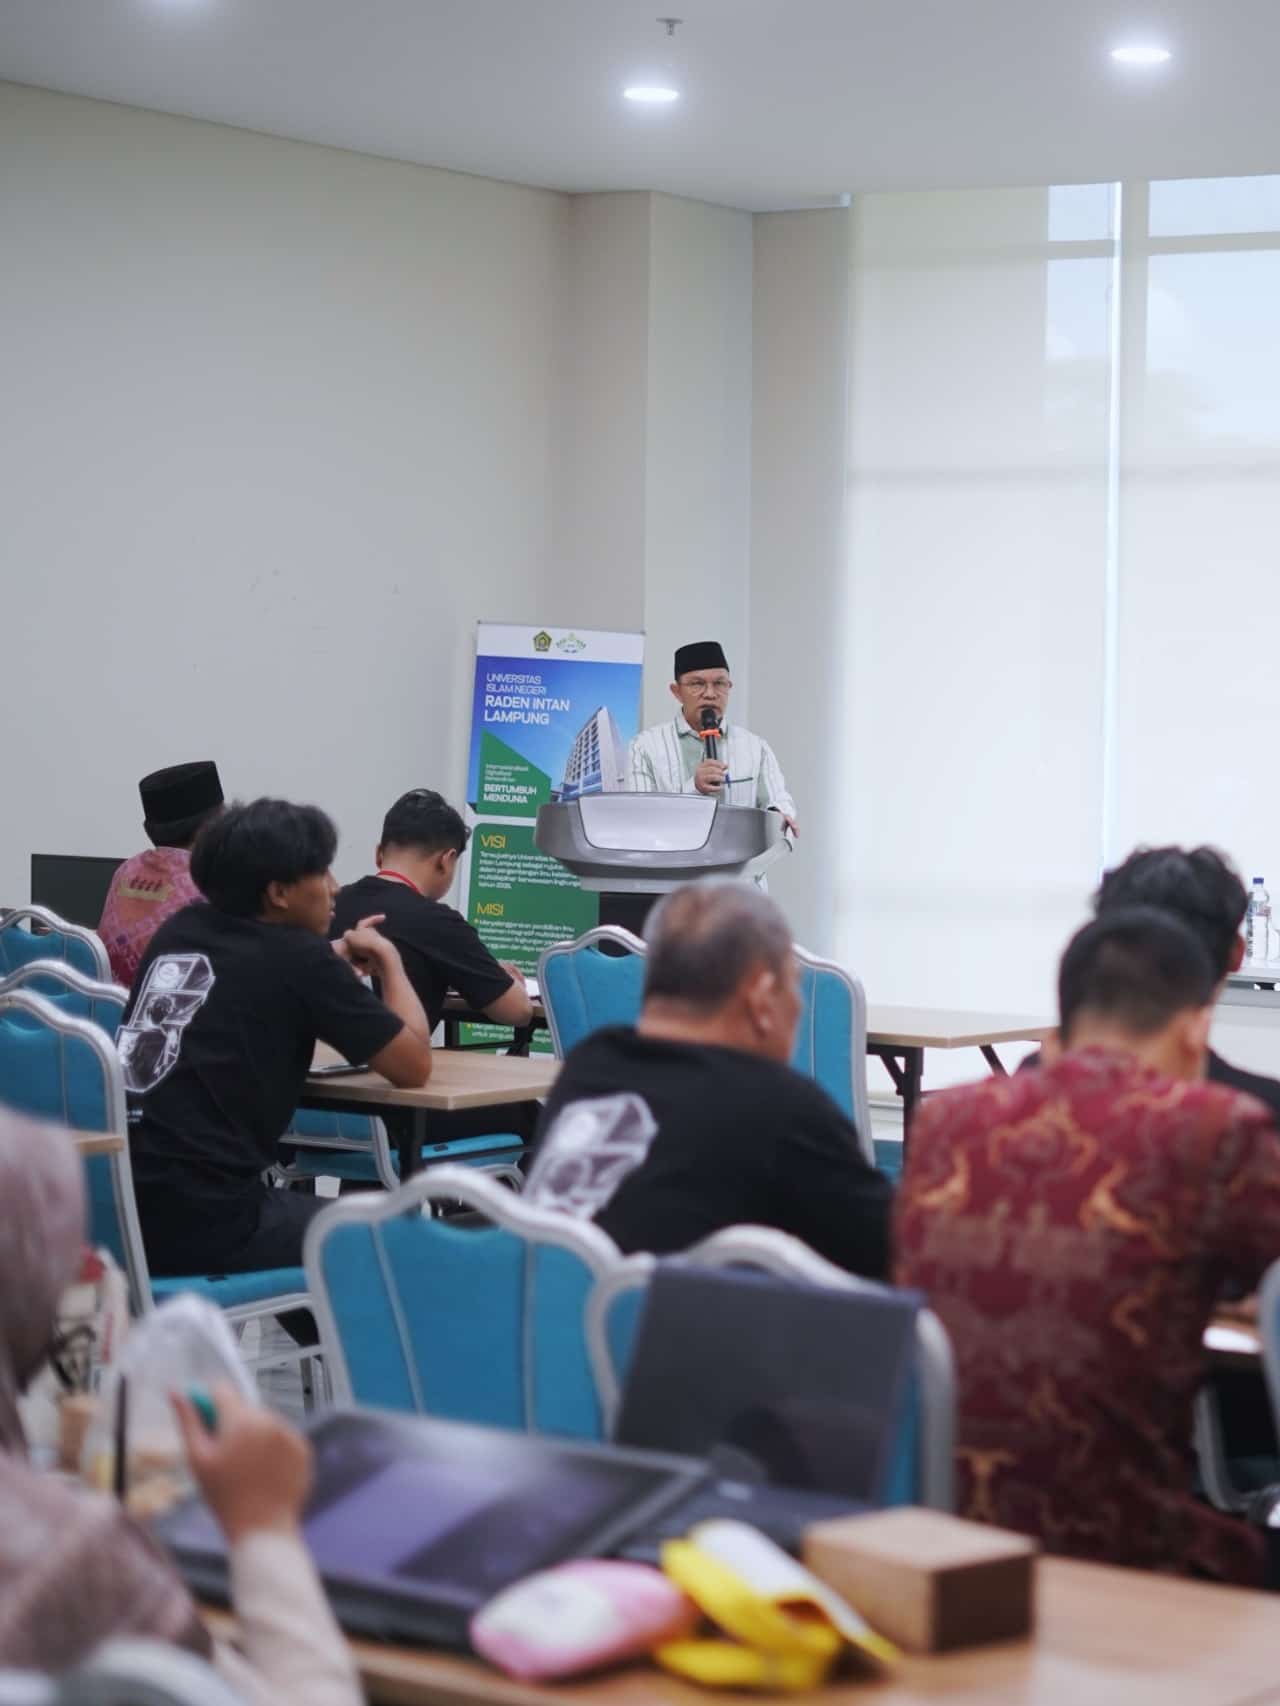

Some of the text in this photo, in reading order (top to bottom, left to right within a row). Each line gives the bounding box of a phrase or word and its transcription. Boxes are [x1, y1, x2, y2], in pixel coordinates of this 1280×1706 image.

[486, 673, 541, 684] UNIVERSITAS
[486, 683, 547, 695] ISLAM NEGERI
[485, 695, 570, 711] RADEN INTAN
[484, 710, 550, 725] LAMPUNG
[484, 783, 537, 795] BERTUMBUH
[481, 834, 506, 849] VISI
[476, 903, 504, 916] MISI
